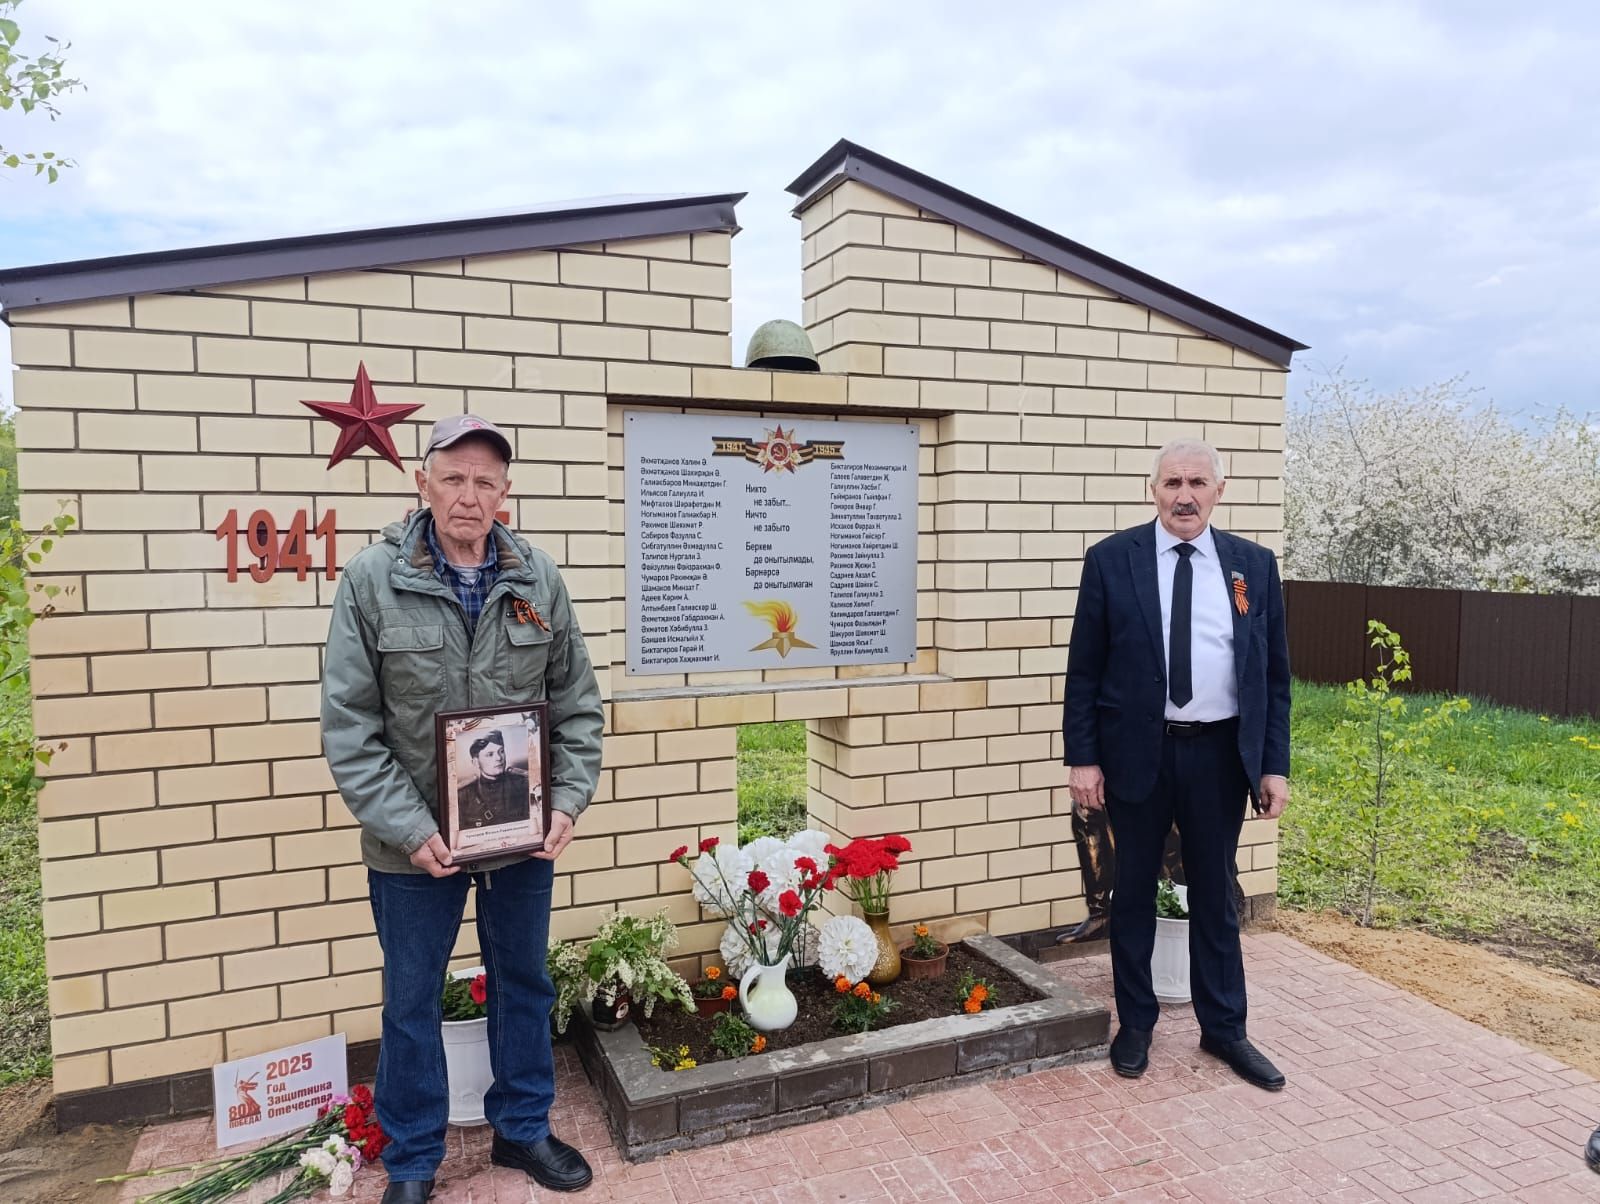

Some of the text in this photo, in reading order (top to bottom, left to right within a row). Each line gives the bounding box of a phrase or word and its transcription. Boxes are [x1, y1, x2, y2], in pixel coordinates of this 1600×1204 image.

[722, 442, 743, 452] 1941
[815, 445, 836, 455] 1945
[745, 484, 767, 493] Никто
[745, 510, 767, 519] Ничто
[754, 523, 790, 532] не забыто
[216, 509, 336, 583] 1941
[746, 542, 772, 552] Беркем
[764, 581, 813, 589] онытылмаган
[266, 1052, 313, 1080] 2025
[266, 1082, 286, 1094] Год
[267, 1081, 332, 1106] Защитника
[267, 1093, 333, 1119] Отечества
